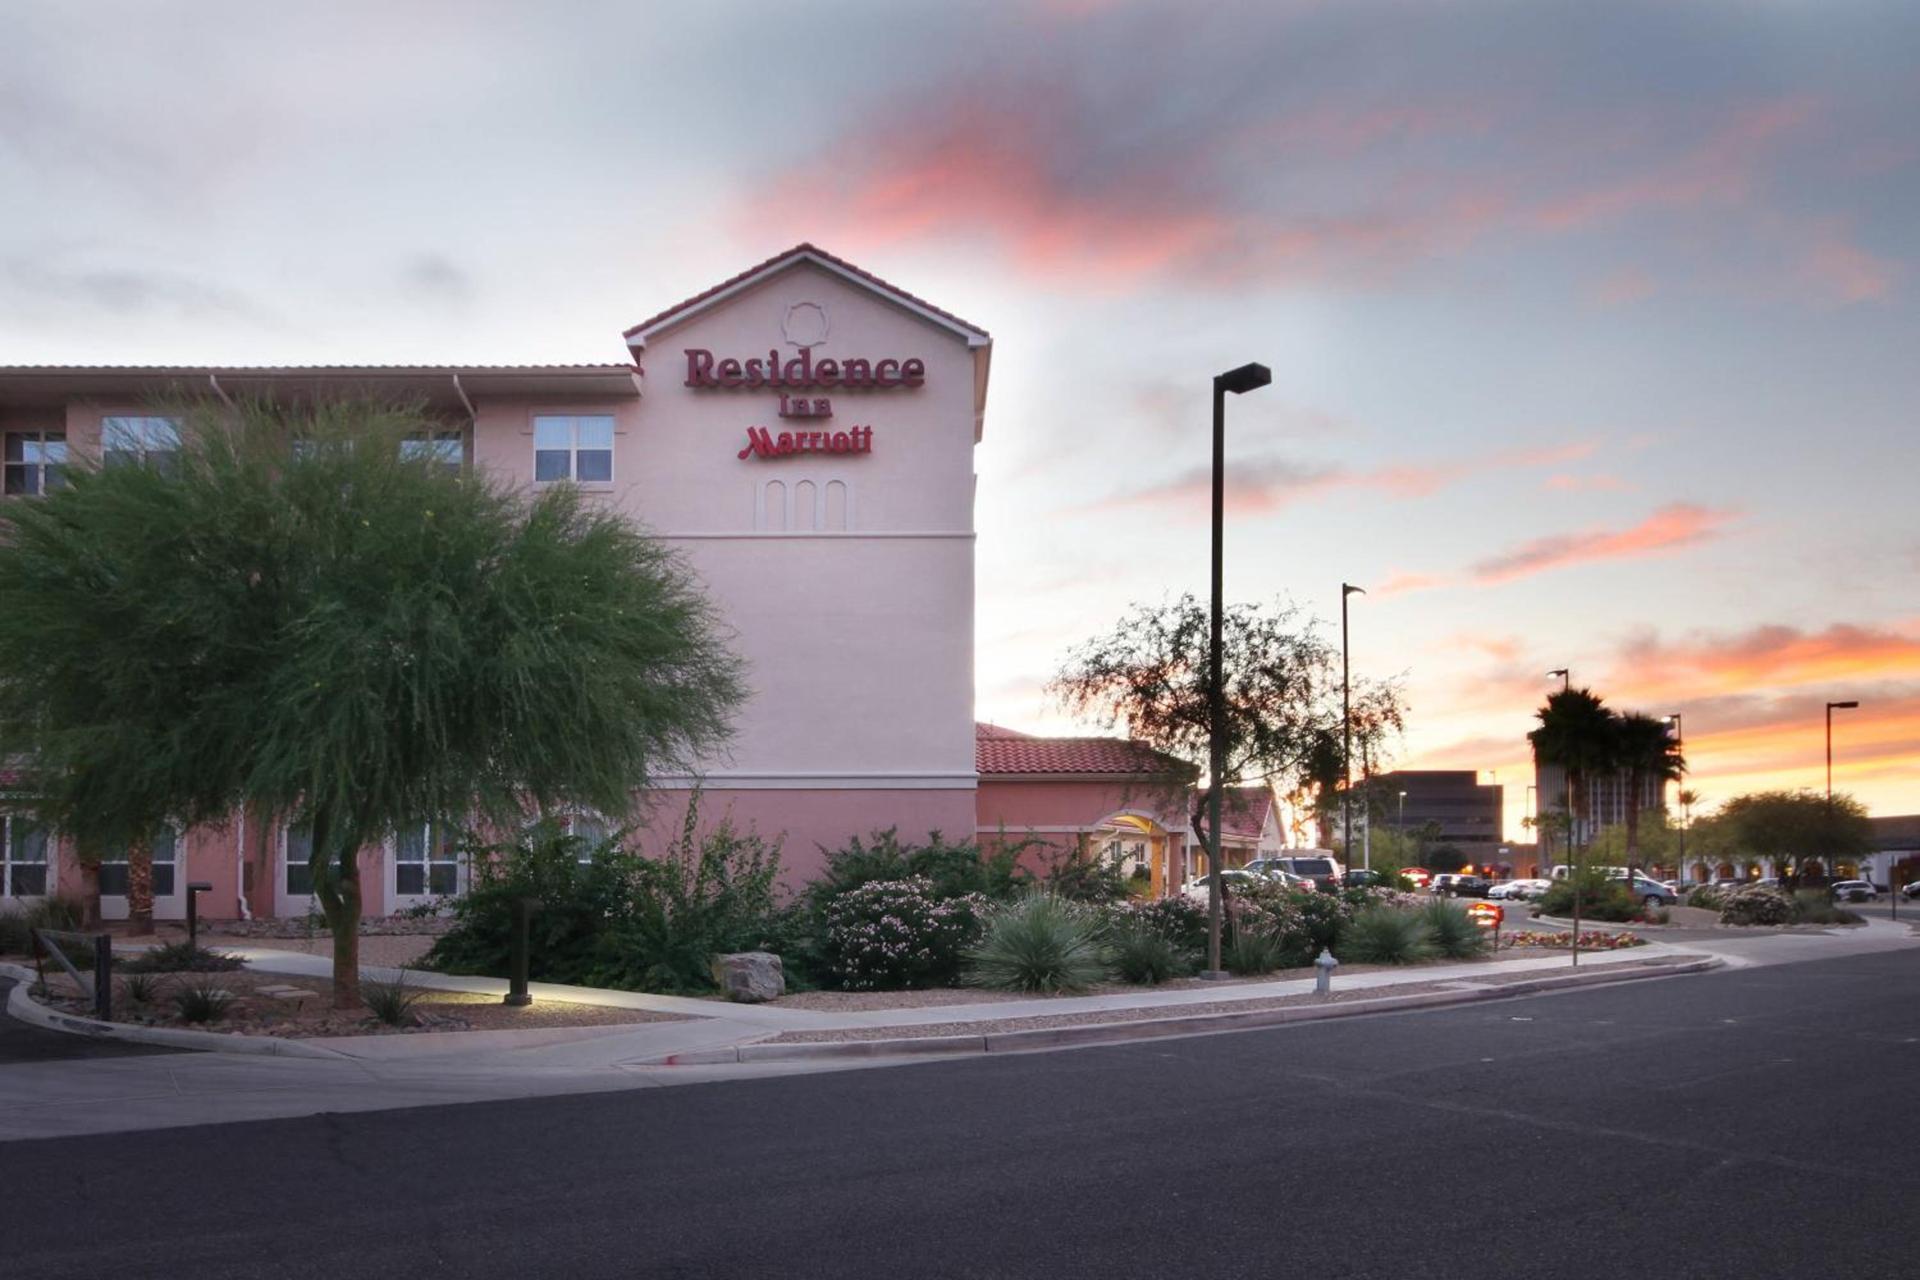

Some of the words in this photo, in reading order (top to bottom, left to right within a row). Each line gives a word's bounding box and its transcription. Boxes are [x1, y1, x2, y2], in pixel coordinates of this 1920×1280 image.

[684, 348, 925, 388] Residence
[778, 393, 833, 417] Inn
[737, 424, 873, 460] Marriott
